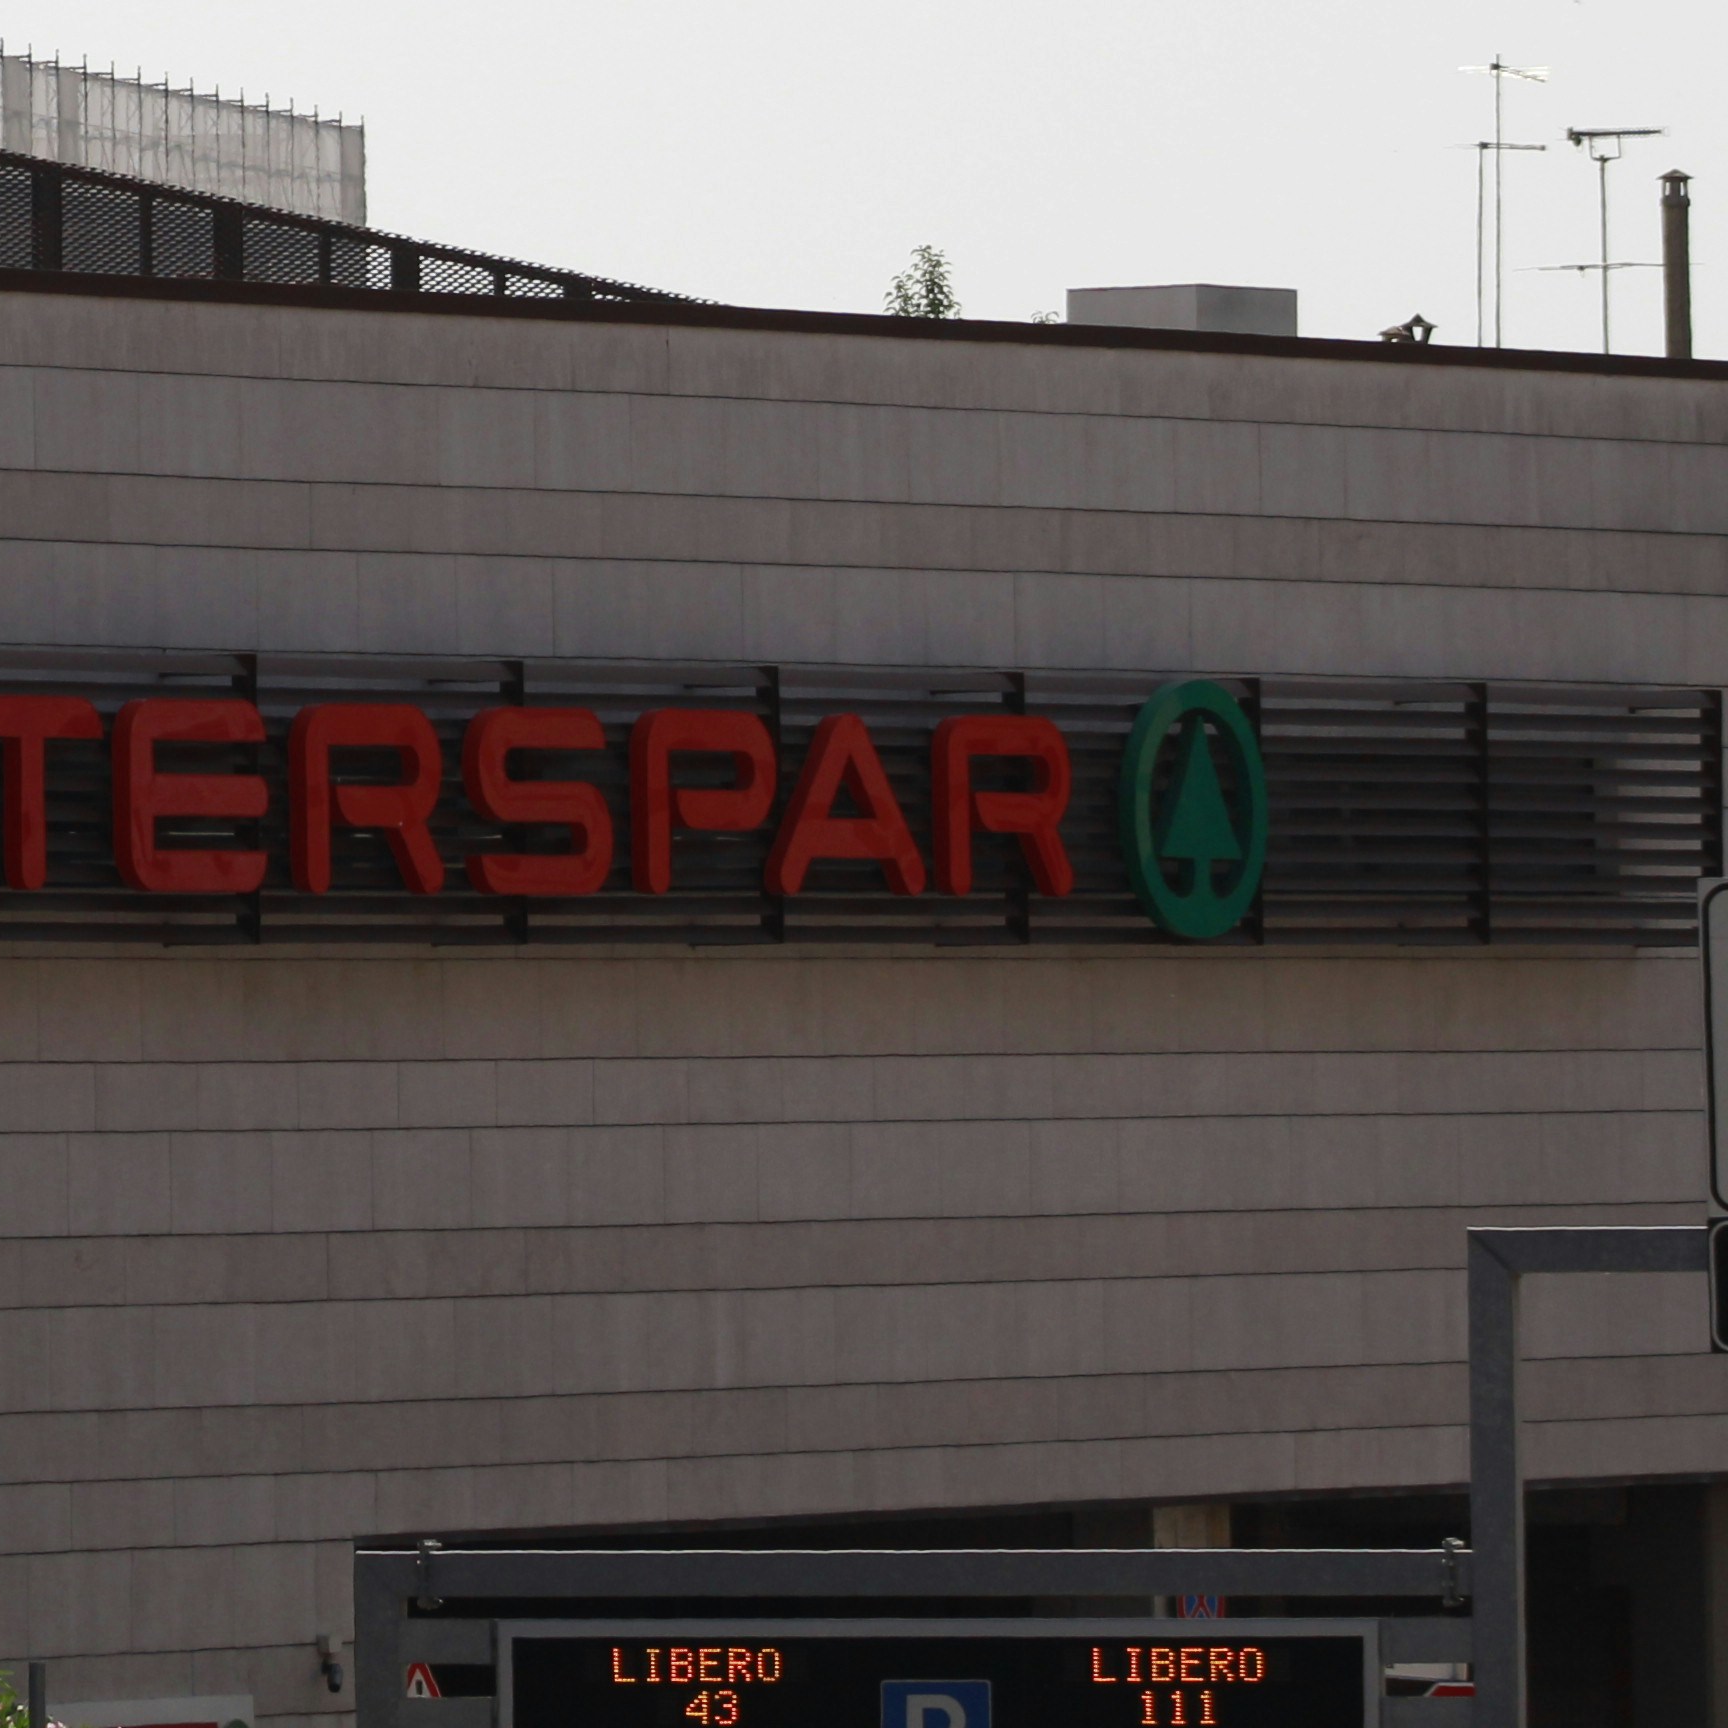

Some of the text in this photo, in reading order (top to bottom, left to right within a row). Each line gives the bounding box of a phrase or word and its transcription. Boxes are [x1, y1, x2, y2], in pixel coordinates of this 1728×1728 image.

[612, 1646, 781, 1683] LIBERO
[1092, 1646, 1265, 1683] LIBERO
[685, 1690, 738, 1726] 43
[1141, 1690, 1216, 1726] 111
